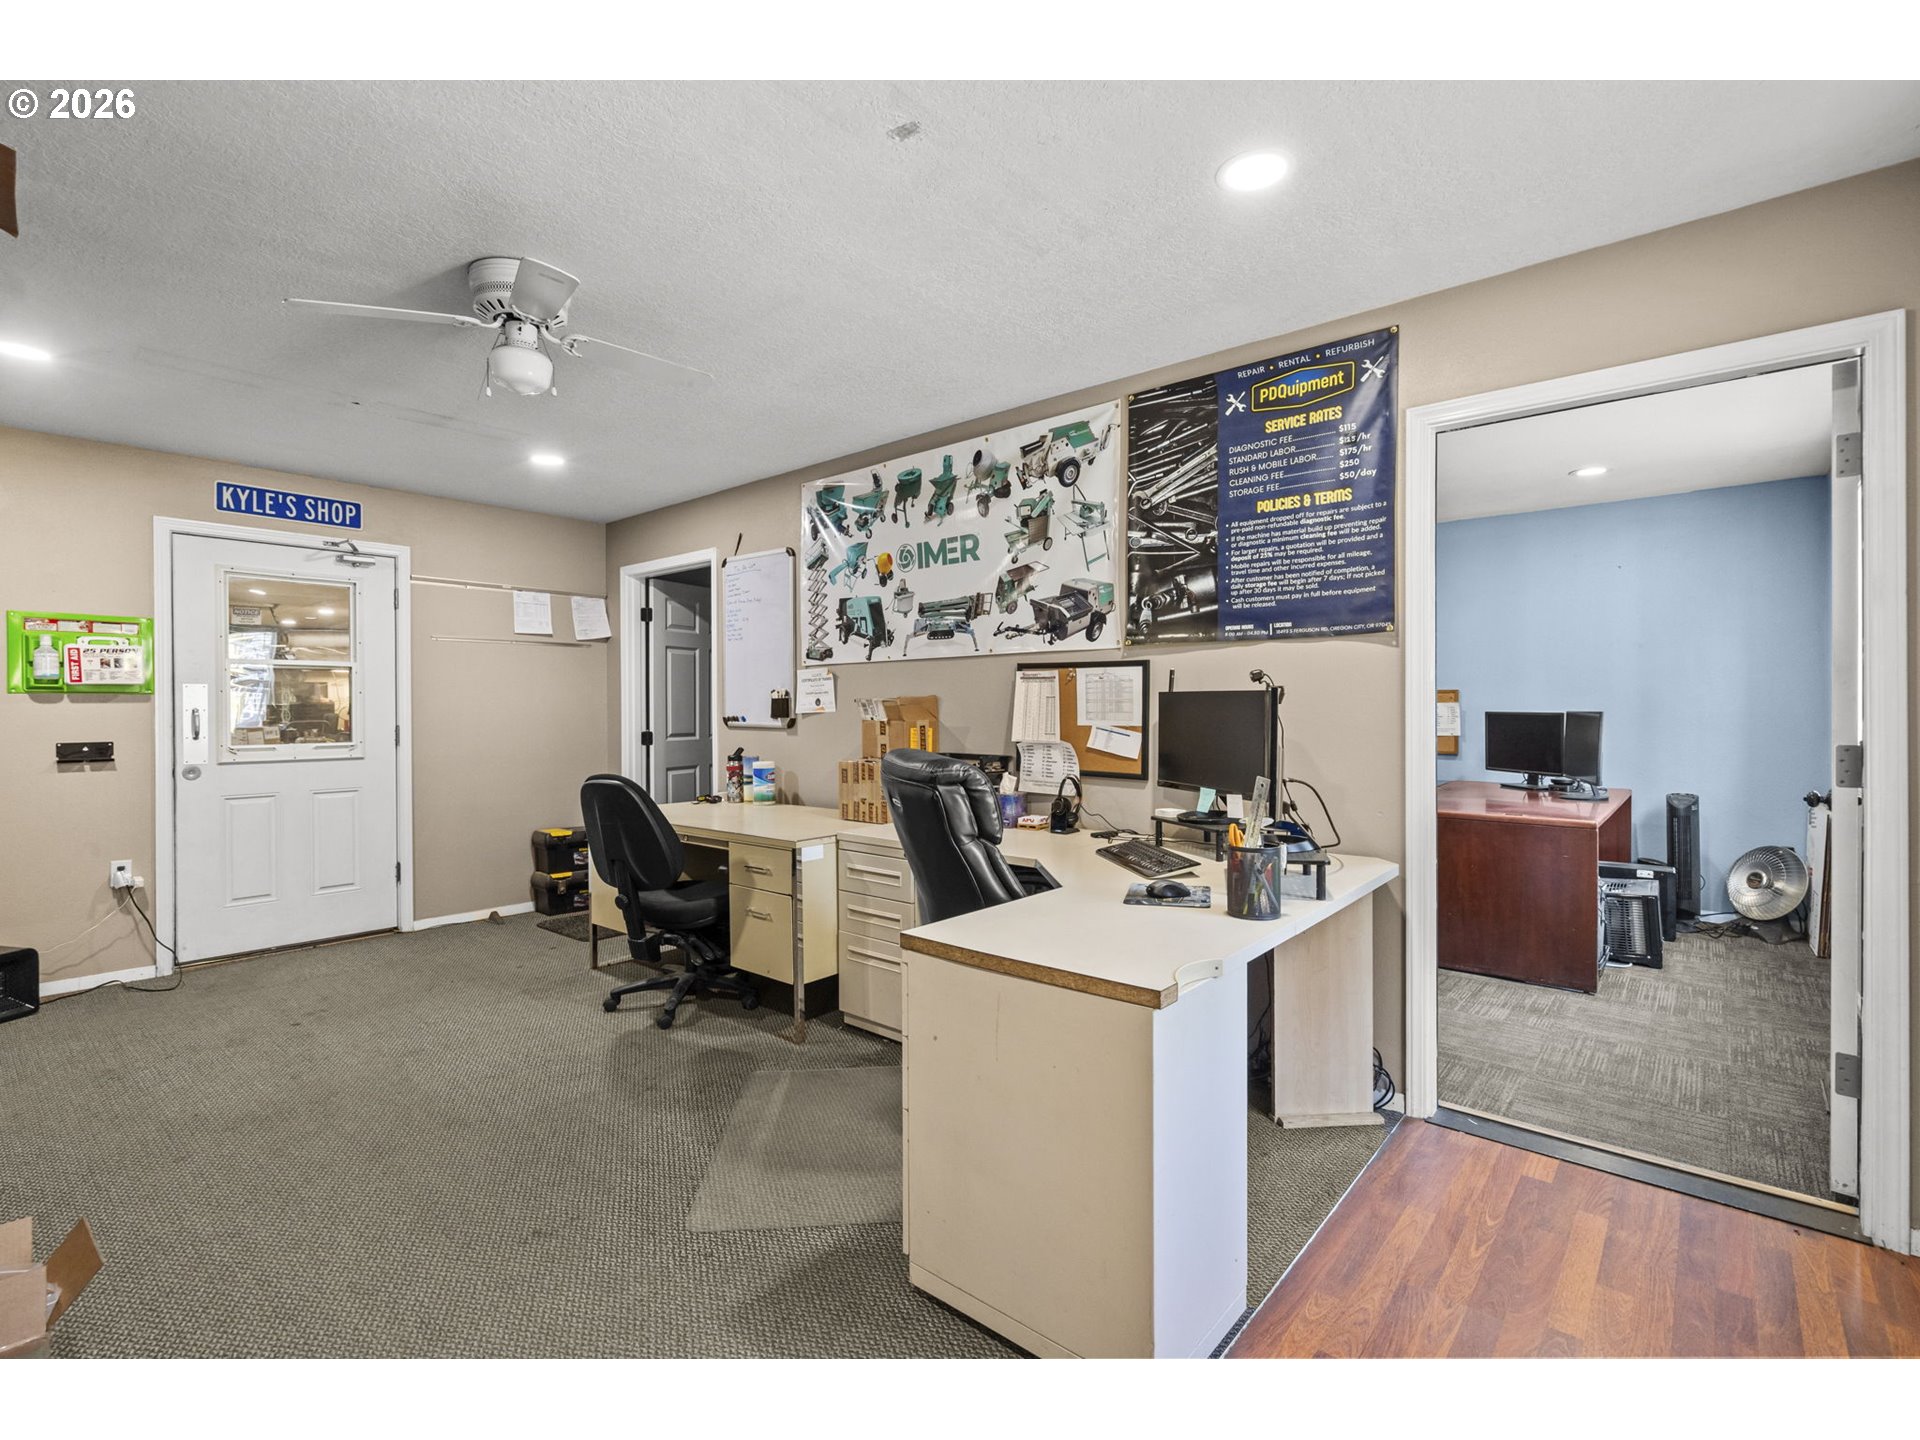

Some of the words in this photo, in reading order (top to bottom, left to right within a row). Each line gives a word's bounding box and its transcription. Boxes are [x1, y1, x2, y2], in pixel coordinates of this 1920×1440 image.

[1237, 366, 1265, 379] REPAIR
[1278, 355, 1311, 369] RENTAL
[1325, 338, 1375, 357] REFURBISH
[1260, 370, 1344, 402] PDQuipment
[1265, 414, 1306, 433] SERVICE
[1309, 406, 1342, 424] RATES
[1229, 438, 1278, 454] DIAGNOSTIC
[1339, 423, 1357, 433] $115
[1229, 451, 1267, 465] STANDARD
[1229, 467, 1249, 476] RUSH
[1258, 459, 1287, 471] MOBILE
[1339, 445, 1372, 456] $175/hr
[1229, 473, 1268, 487] CLEANING
[1339, 458, 1360, 468] $250
[1229, 483, 1264, 498] STORAGE
[1339, 468, 1376, 480] $50/day
[222, 486, 297, 518] KYLE'S
[304, 498, 356, 525] SHOP
[1257, 496, 1300, 513] POLICIES
[1304, 494, 1311, 507] &
[1314, 488, 1352, 506] TERMS
[1240, 518, 1269, 527] equipment
[1270, 514, 1294, 523] dropped
[1351, 503, 1374, 511] subject
[1255, 520, 1298, 530] non-refundable
[1300, 515, 1332, 524] diagnostic
[1334, 520, 1367, 530] preventing
[1238, 539, 1266, 547] diagnostic
[1300, 531, 1326, 539] cleaning
[1242, 548, 1257, 556] larger
[1338, 534, 1365, 544] provided
[917, 534, 980, 569] IMER
[1292, 554, 1326, 564] responsible
[1365, 569, 1385, 578] picked
[1343, 586, 1376, 594] equipment
[71, 649, 80, 660] AID
[70, 661, 80, 681] FIRST
